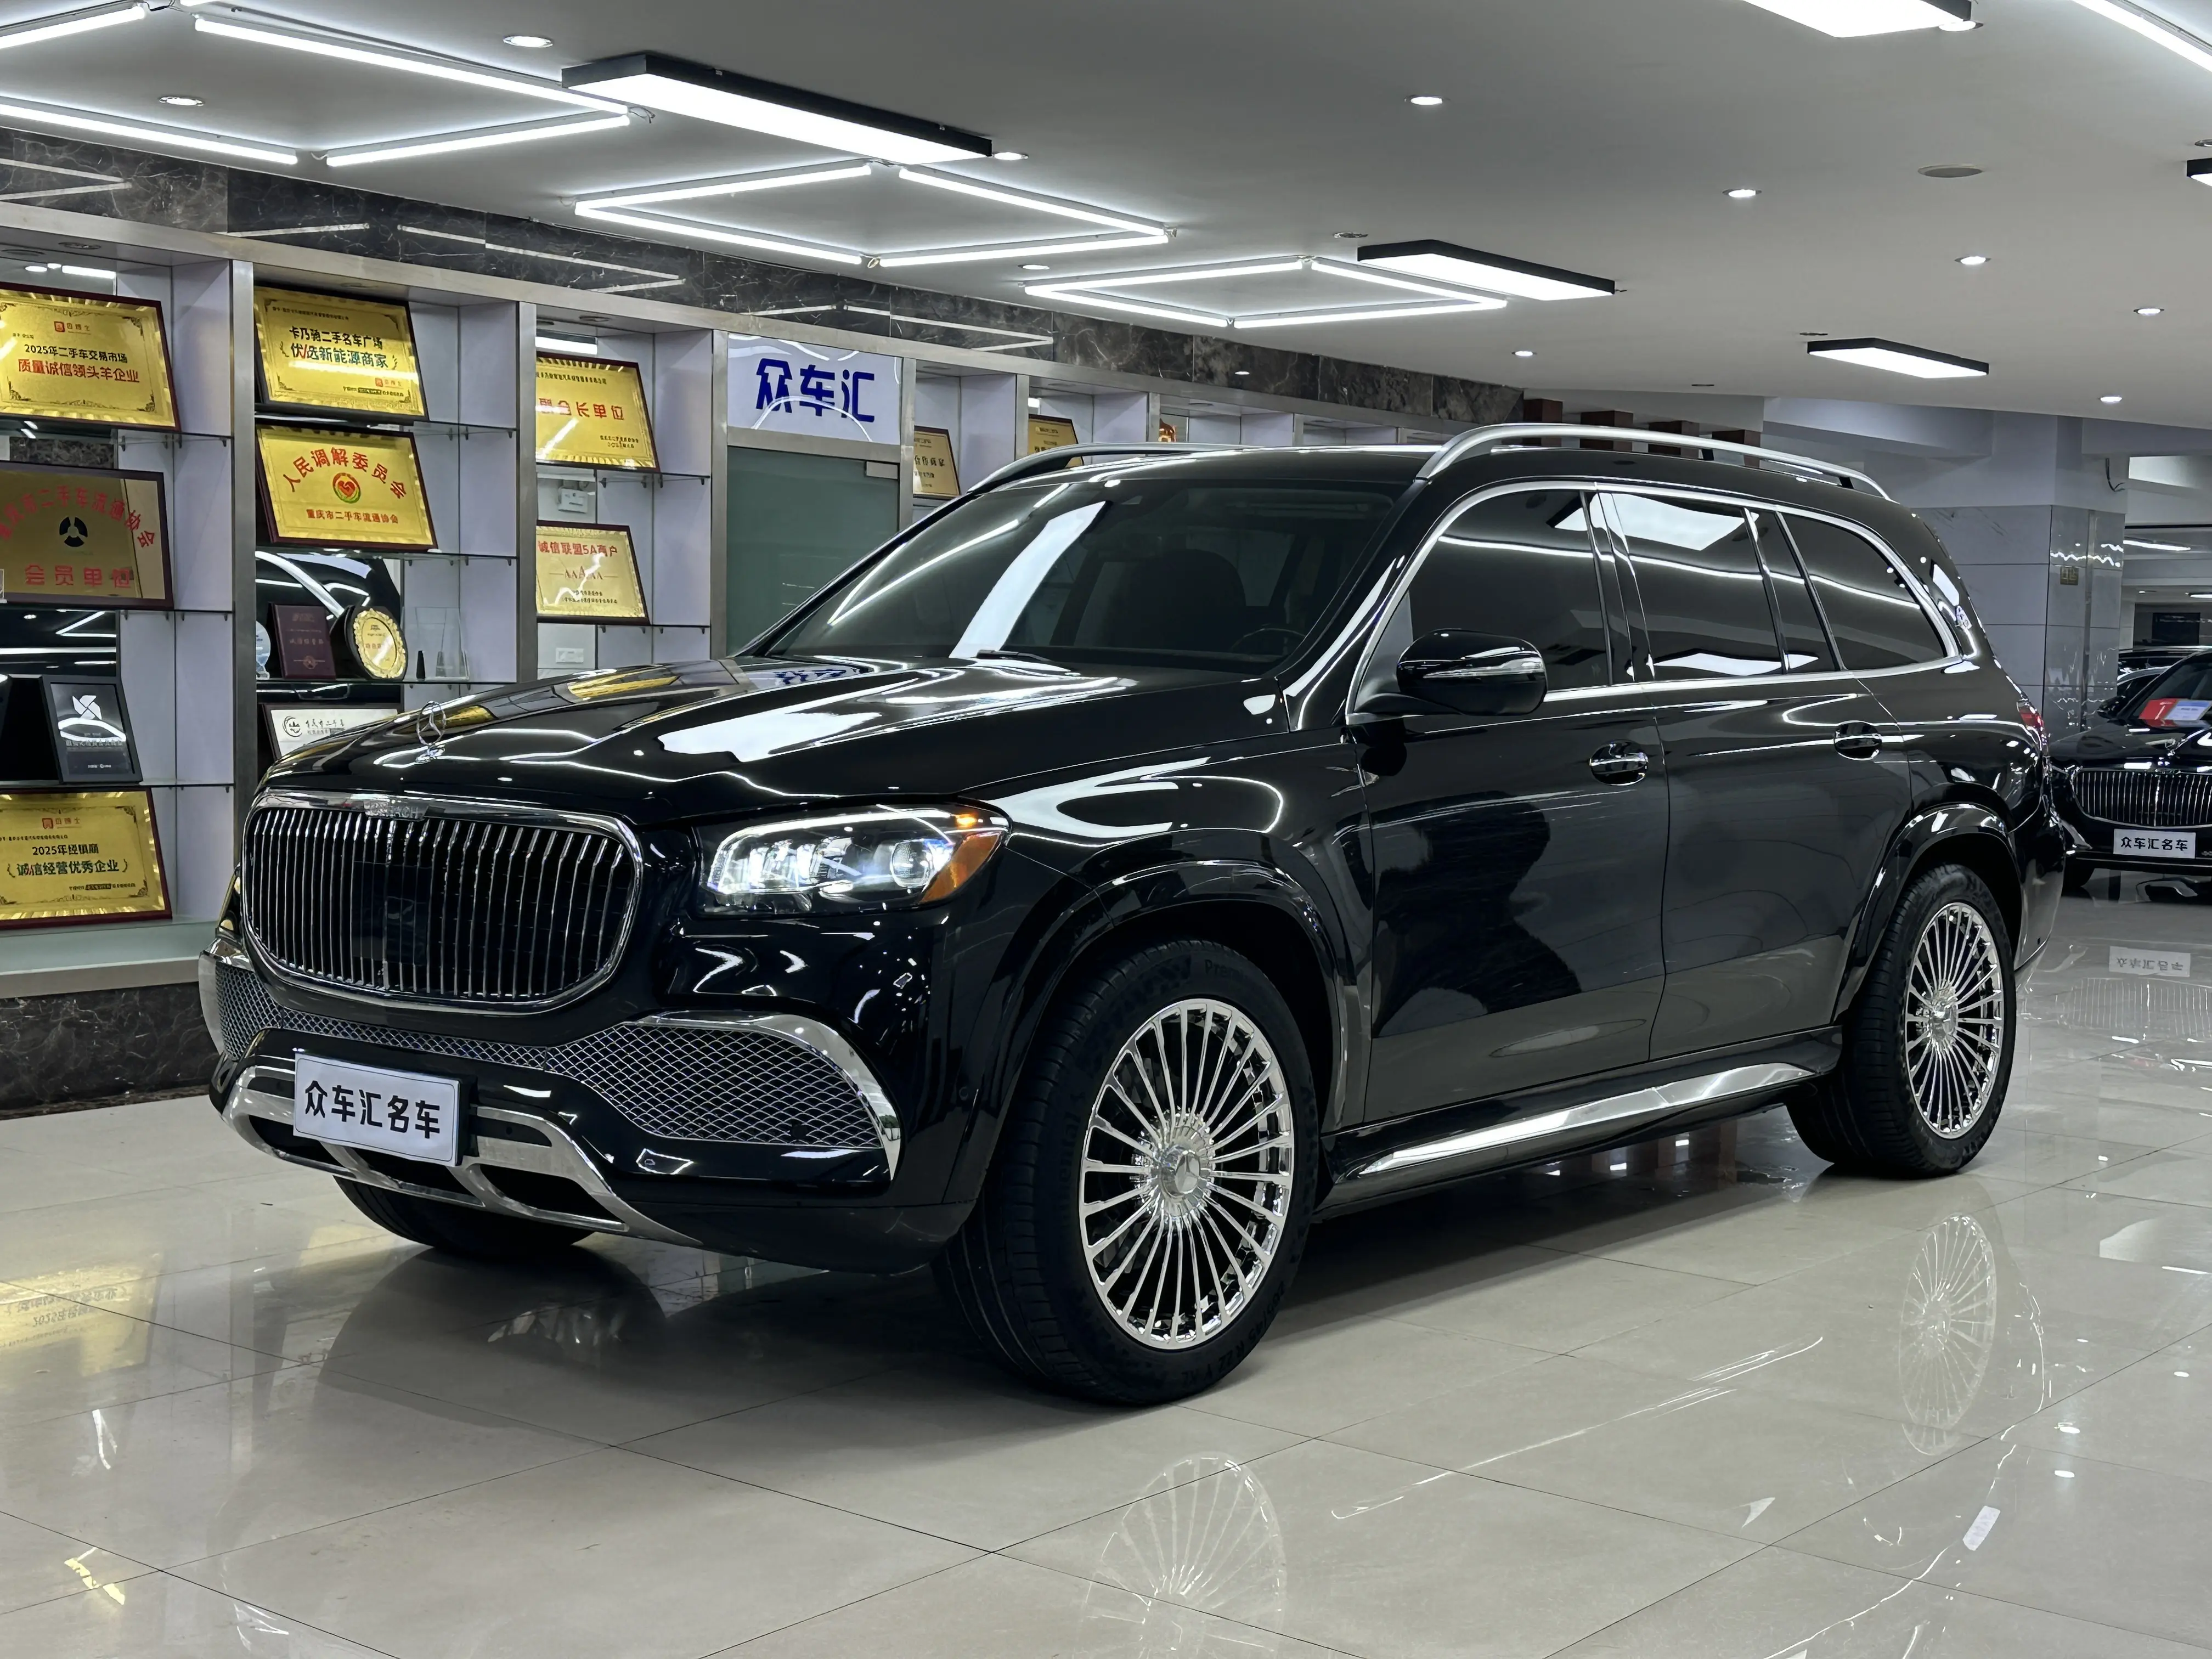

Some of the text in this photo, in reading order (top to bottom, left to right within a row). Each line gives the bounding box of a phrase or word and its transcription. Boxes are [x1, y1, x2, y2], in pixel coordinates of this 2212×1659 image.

[24, 343, 128, 363] 2025年二手车交易市场
[290, 342, 388, 368] 优选新能源商家
[18, 358, 140, 383] 质量诚信领头羊企业
[755, 358, 875, 422] 众车汇
[283, 447, 407, 499] 人民调解委员会
[25, 565, 131, 588] 会员单位
[2120, 837, 2188, 851] 众车汇名车
[16, 859, 120, 877] 诚信经营优秀企业
[305, 1080, 441, 1139] 众车汇名车
